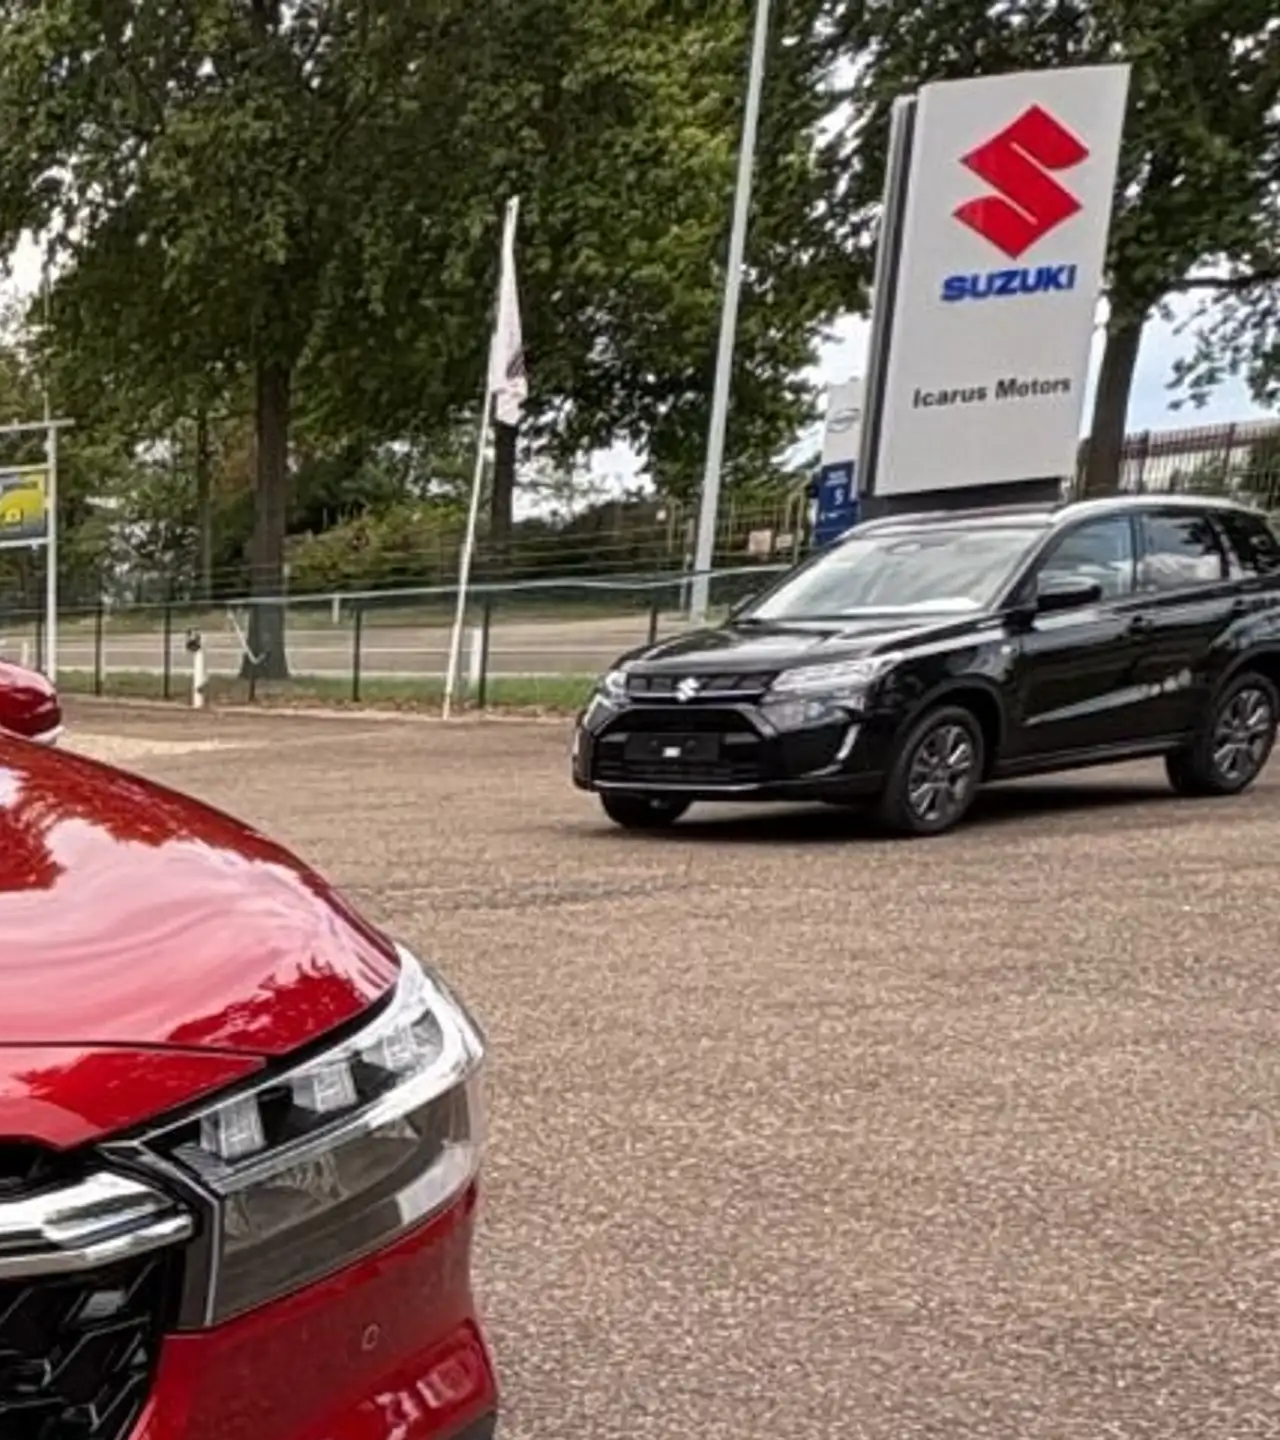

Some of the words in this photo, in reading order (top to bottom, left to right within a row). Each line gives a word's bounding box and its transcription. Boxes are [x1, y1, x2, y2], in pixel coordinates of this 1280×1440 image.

[941, 264, 1077, 302] SUZUKI
[913, 386, 987, 409] Icarus
[995, 377, 1072, 400] Motors
